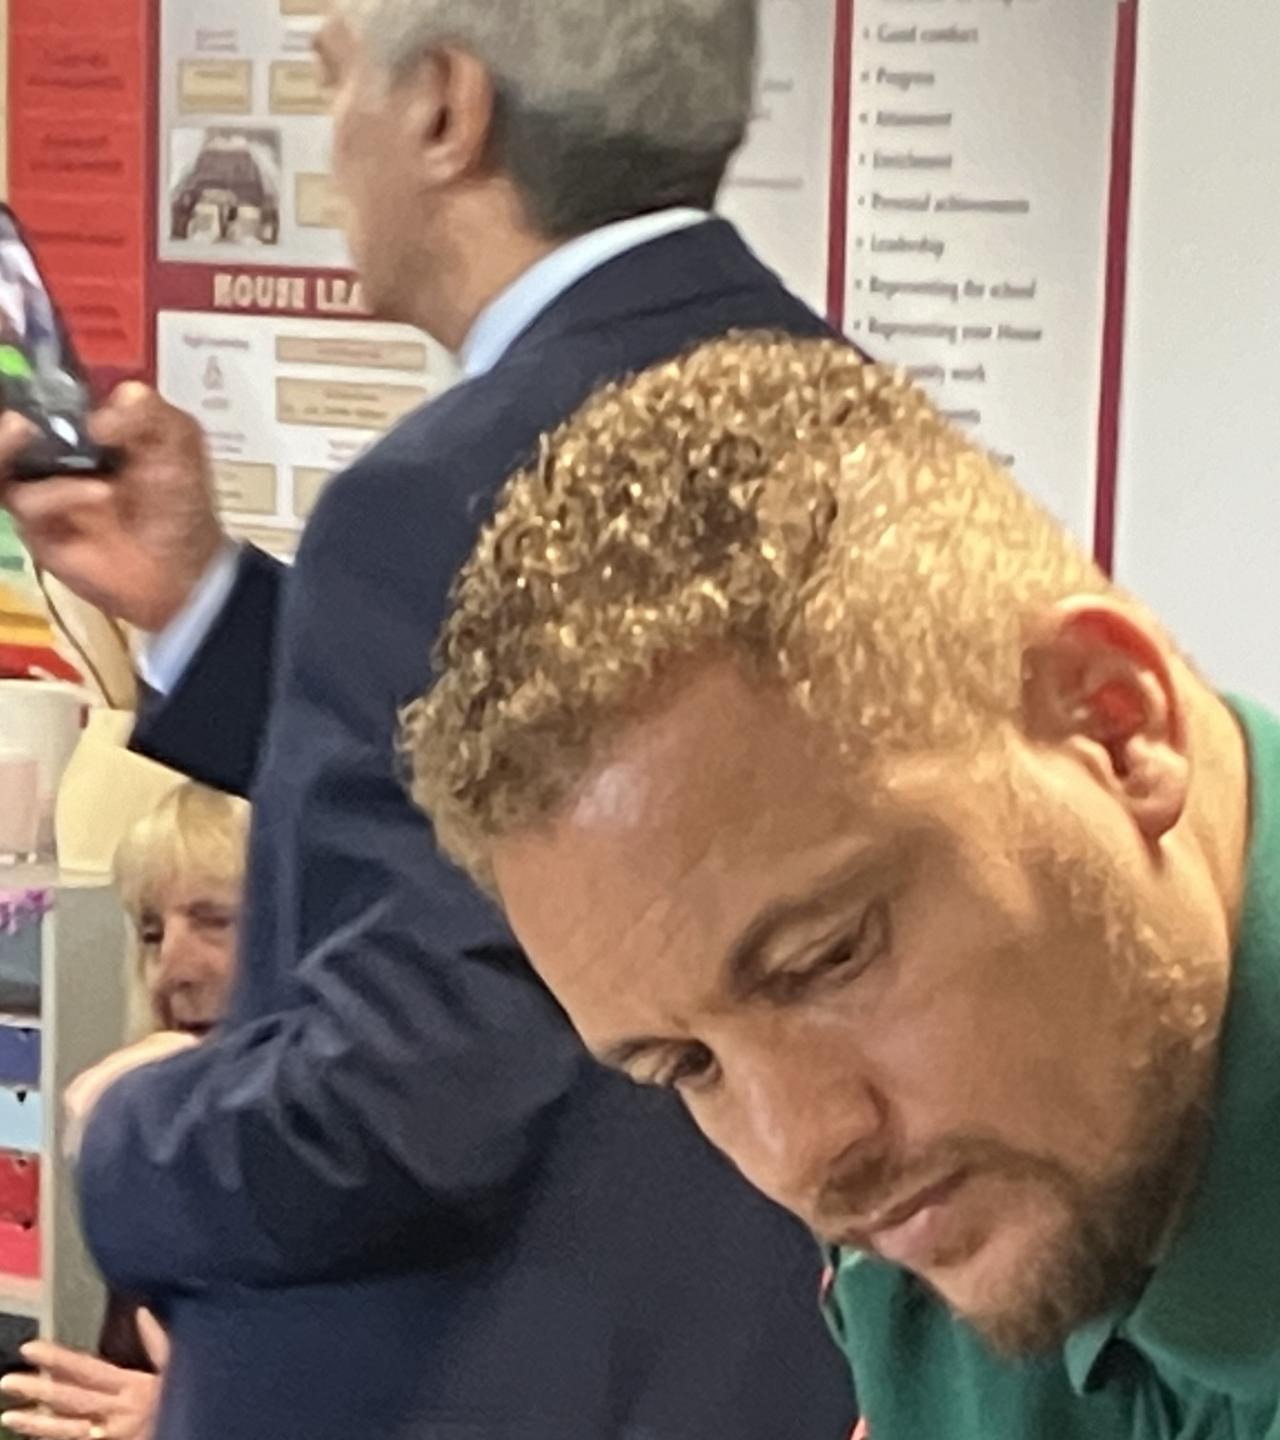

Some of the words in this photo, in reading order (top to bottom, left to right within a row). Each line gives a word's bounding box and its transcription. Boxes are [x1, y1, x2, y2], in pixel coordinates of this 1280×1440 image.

[877, 24, 916, 42] Good
[920, 25, 978, 42] conduct
[876, 67, 934, 89] Progress
[871, 192, 930, 212] Personal
[870, 234, 944, 259] Leadership
[214, 274, 305, 310] HOUSE
[316, 277, 364, 314] LEA
[869, 276, 958, 301] Representing
[962, 278, 986, 298] the
[989, 278, 1036, 298] school
[868, 317, 957, 344] Representing
[951, 364, 986, 382] work
